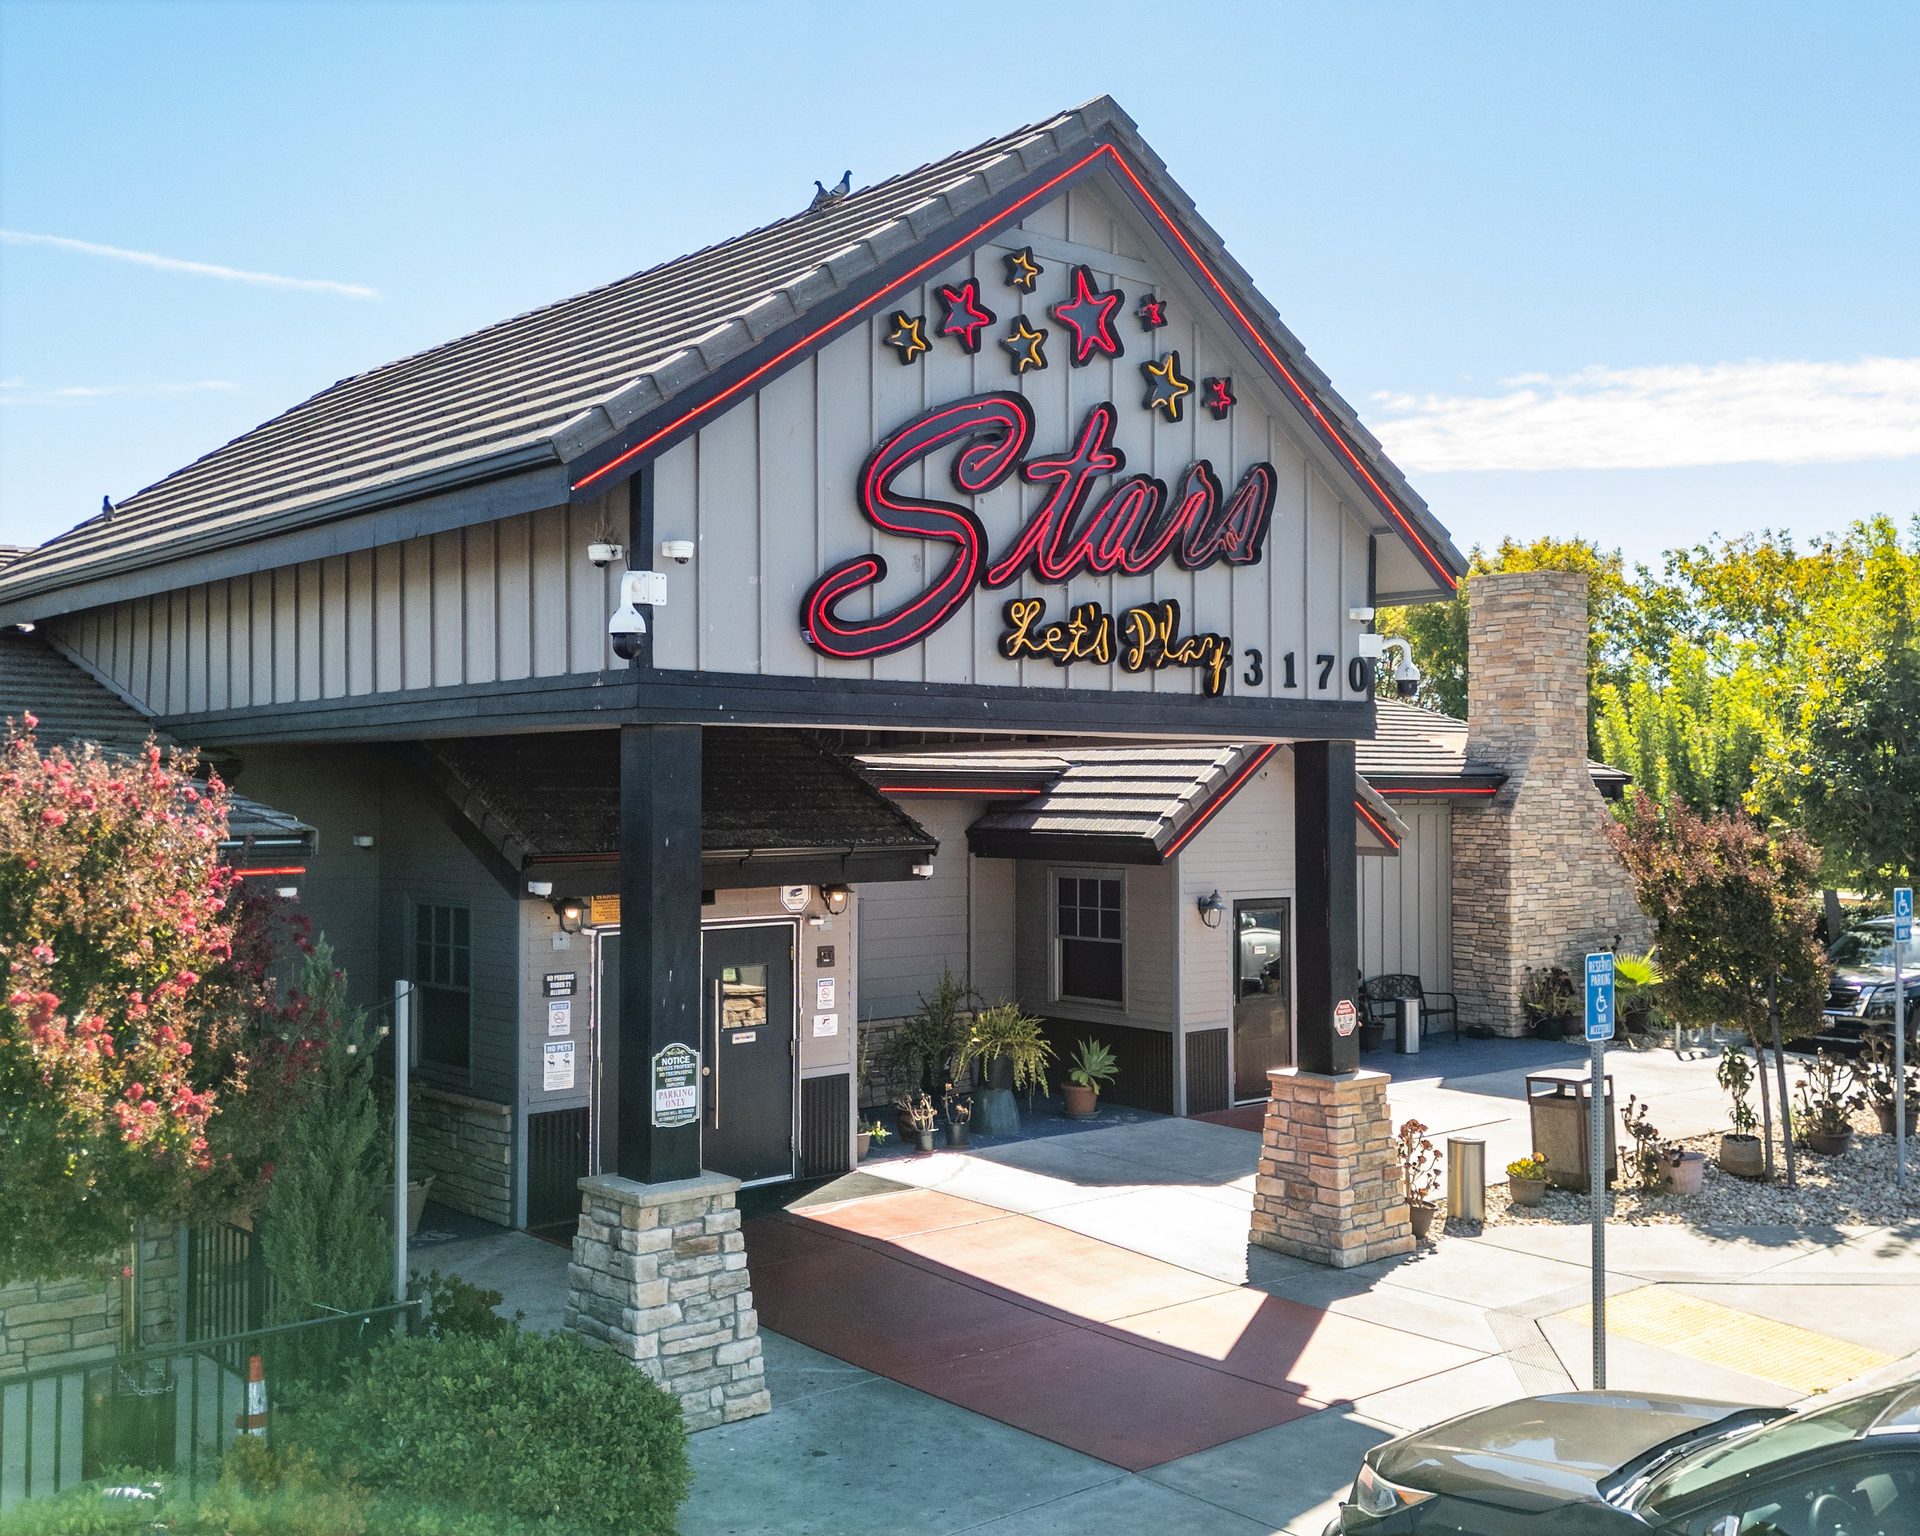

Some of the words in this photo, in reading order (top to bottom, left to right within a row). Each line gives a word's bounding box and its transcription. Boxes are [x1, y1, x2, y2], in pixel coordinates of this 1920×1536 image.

[801, 391, 1278, 660] Stars
[1001, 598, 1116, 666] Let's
[1119, 599, 1233, 697] Play
[1590, 973, 1611, 987] PARKING
[547, 1044, 556, 1054] NO
[556, 1043, 572, 1053] PETS
[662, 1056, 690, 1065] NOTICE
[658, 1088, 693, 1100] PARKING
[665, 1098, 686, 1108] ONLY
